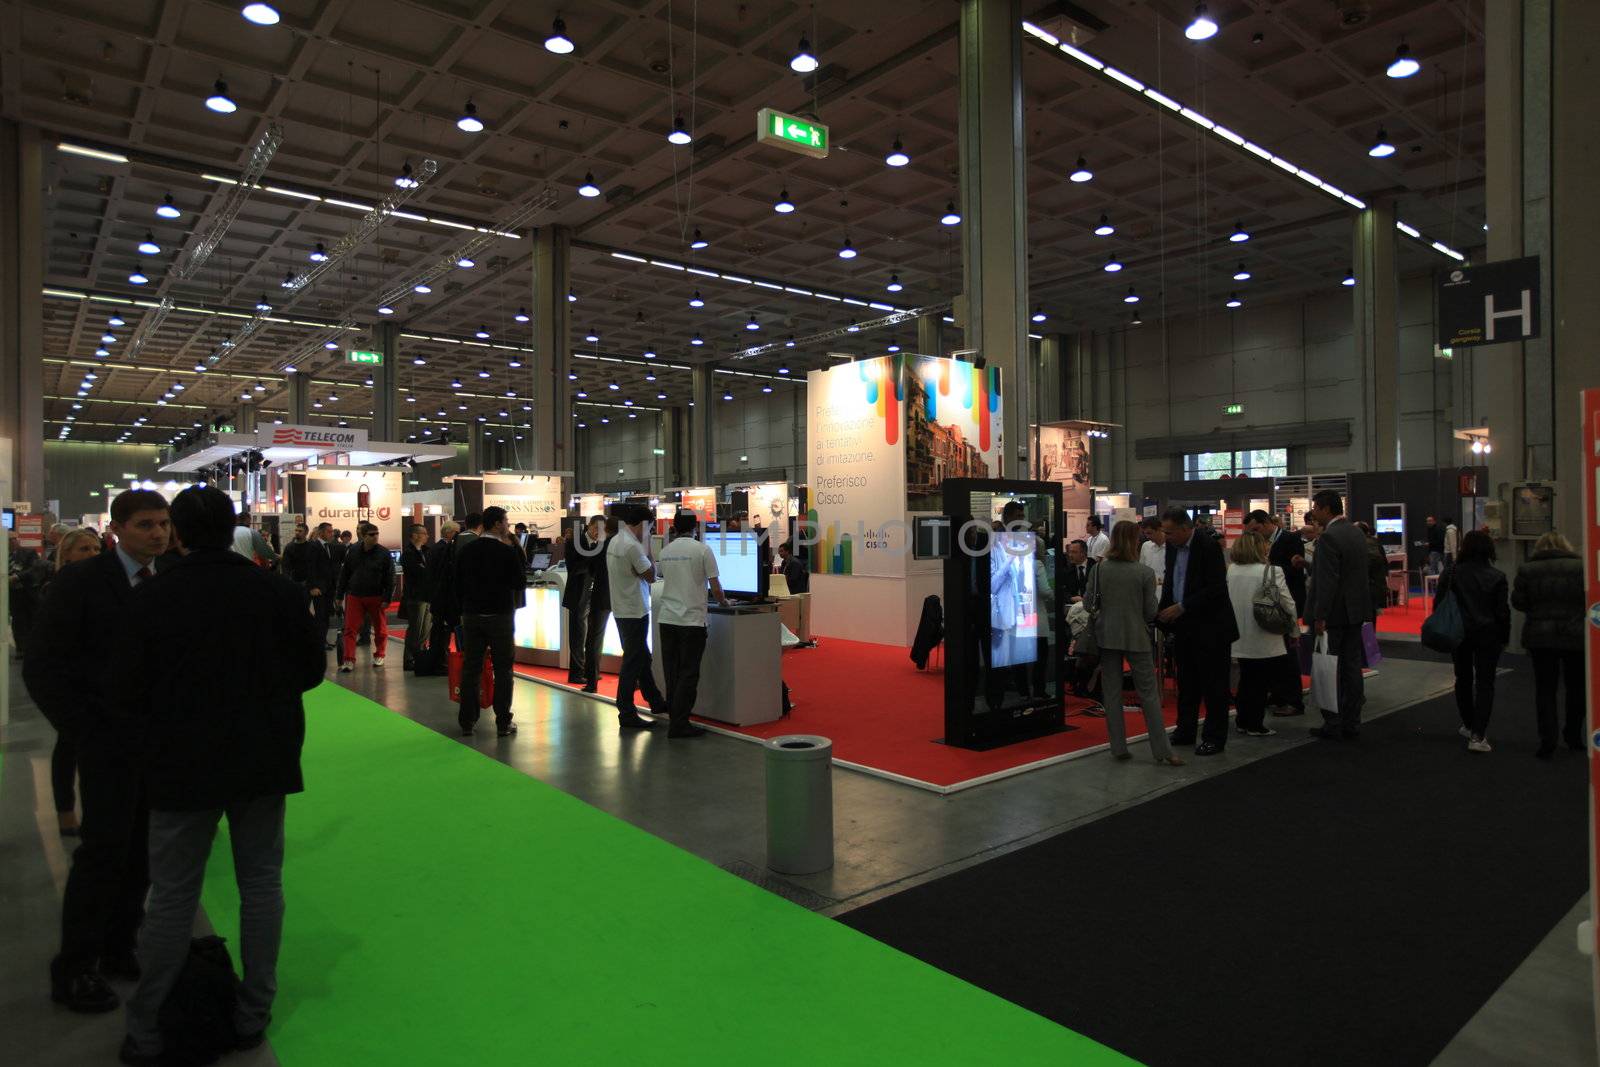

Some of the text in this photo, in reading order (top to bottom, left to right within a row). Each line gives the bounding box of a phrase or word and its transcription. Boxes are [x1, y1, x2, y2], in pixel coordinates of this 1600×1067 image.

[1485, 289, 1531, 340] H
[304, 431, 355, 443] TELECOM
[816, 474, 868, 489] Preferisco
[318, 507, 375, 518] durante
